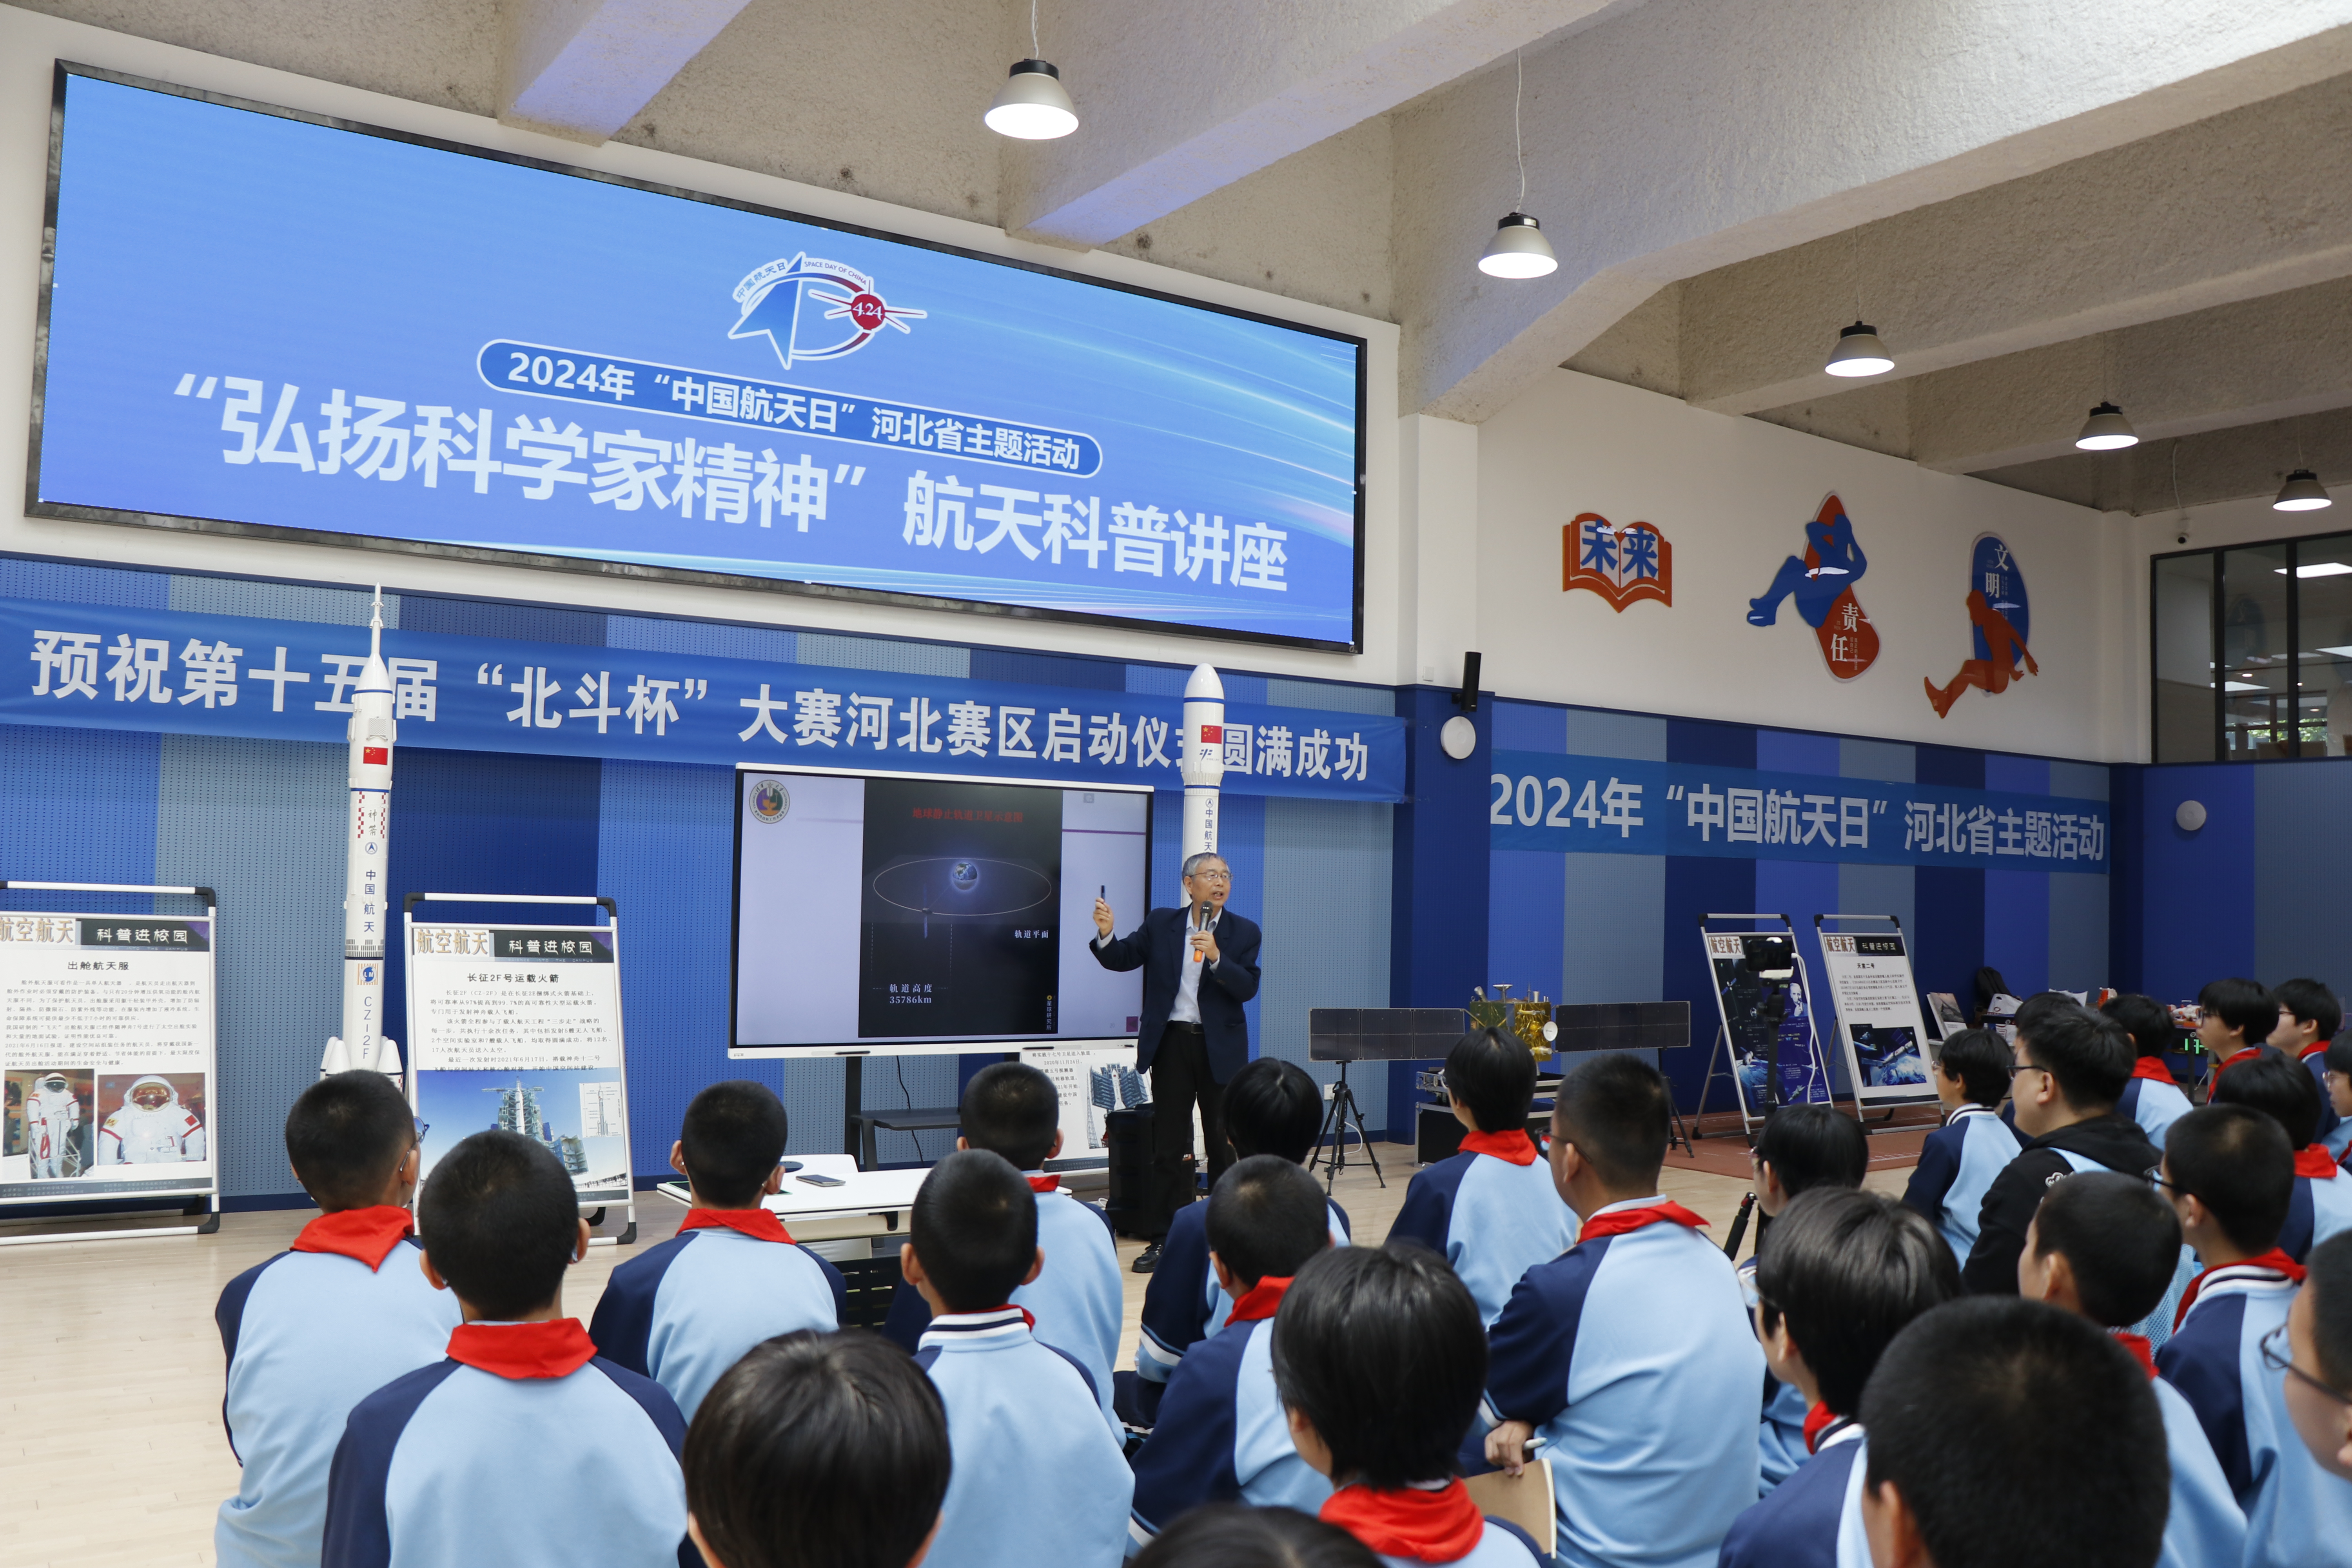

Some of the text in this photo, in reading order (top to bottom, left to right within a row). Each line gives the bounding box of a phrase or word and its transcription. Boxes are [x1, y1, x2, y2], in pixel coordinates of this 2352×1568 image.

[848, 270, 867, 285] CHINA
[853, 302, 883, 320] 4.24
[508, 352, 635, 401] 2024年
[871, 407, 1080, 470] 河北省主题活动
[902, 470, 1288, 592] 航天科普讲座
[1580, 519, 1659, 579] 未来
[1985, 544, 2009, 598] 文明
[1830, 603, 1859, 662] 责任
[478, 662, 707, 737] “北斗杯”
[738, 684, 1368, 781] 大赛河北赛区启动仪圆满成功
[1204, 808, 1213, 851] 中国航天
[1490, 774, 1644, 838] 2024年
[1905, 799, 2105, 861] 河北省主题活动
[364, 870, 376, 933] 中国航天
[0, 917, 188, 944] 航空航天 科普进校园
[416, 928, 593, 956] 航空航天 科普进校园
[1014, 930, 1049, 938] 轨道平面
[68, 961, 129, 970] 出舱航天服
[467, 973, 559, 983] 长征2F号运载火箭
[889, 984, 932, 993] 轨道高度
[890, 995, 931, 1004] 35786km
